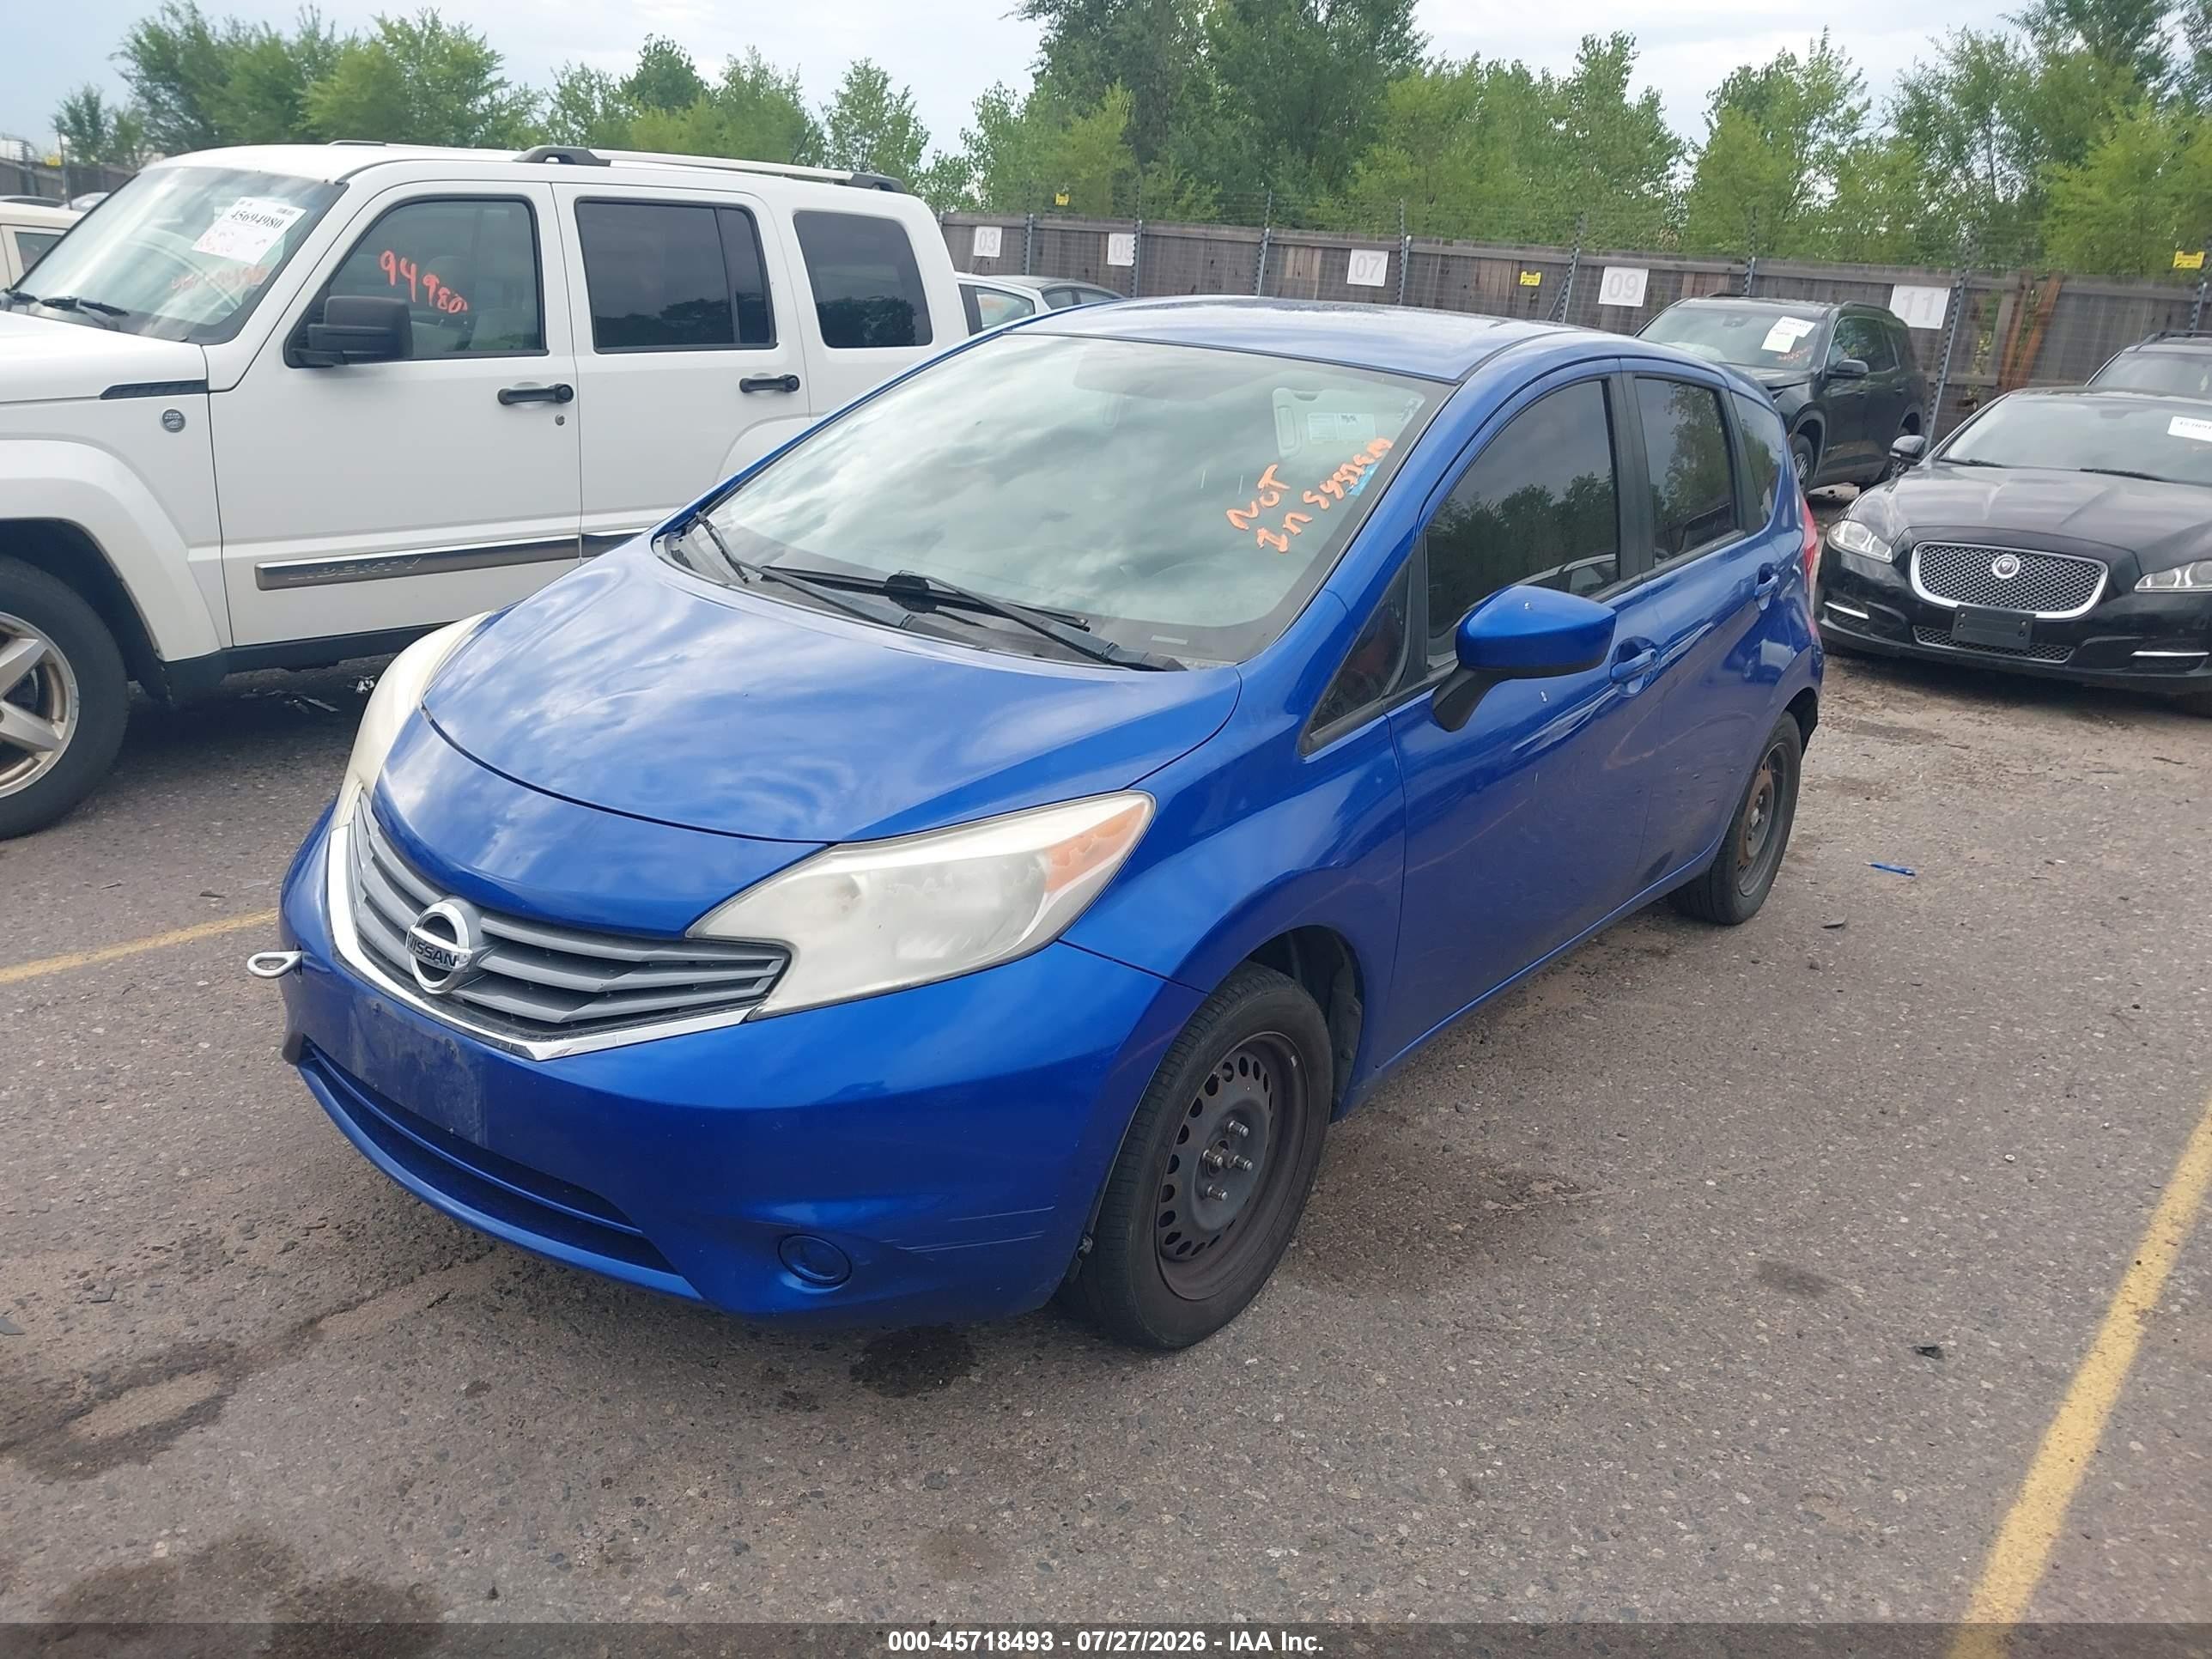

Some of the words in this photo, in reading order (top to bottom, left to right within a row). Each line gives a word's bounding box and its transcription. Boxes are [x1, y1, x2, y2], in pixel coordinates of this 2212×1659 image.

[229, 209, 285, 229] 45694980
[979, 232, 997, 251] 03
[1355, 255, 1382, 279] 07
[380, 250, 468, 313] 94980
[1607, 272, 1640, 299] 09
[1902, 291, 1936, 321] 11
[288, 556, 422, 581] LIBERTY
[406, 933, 458, 967] NISSAN
